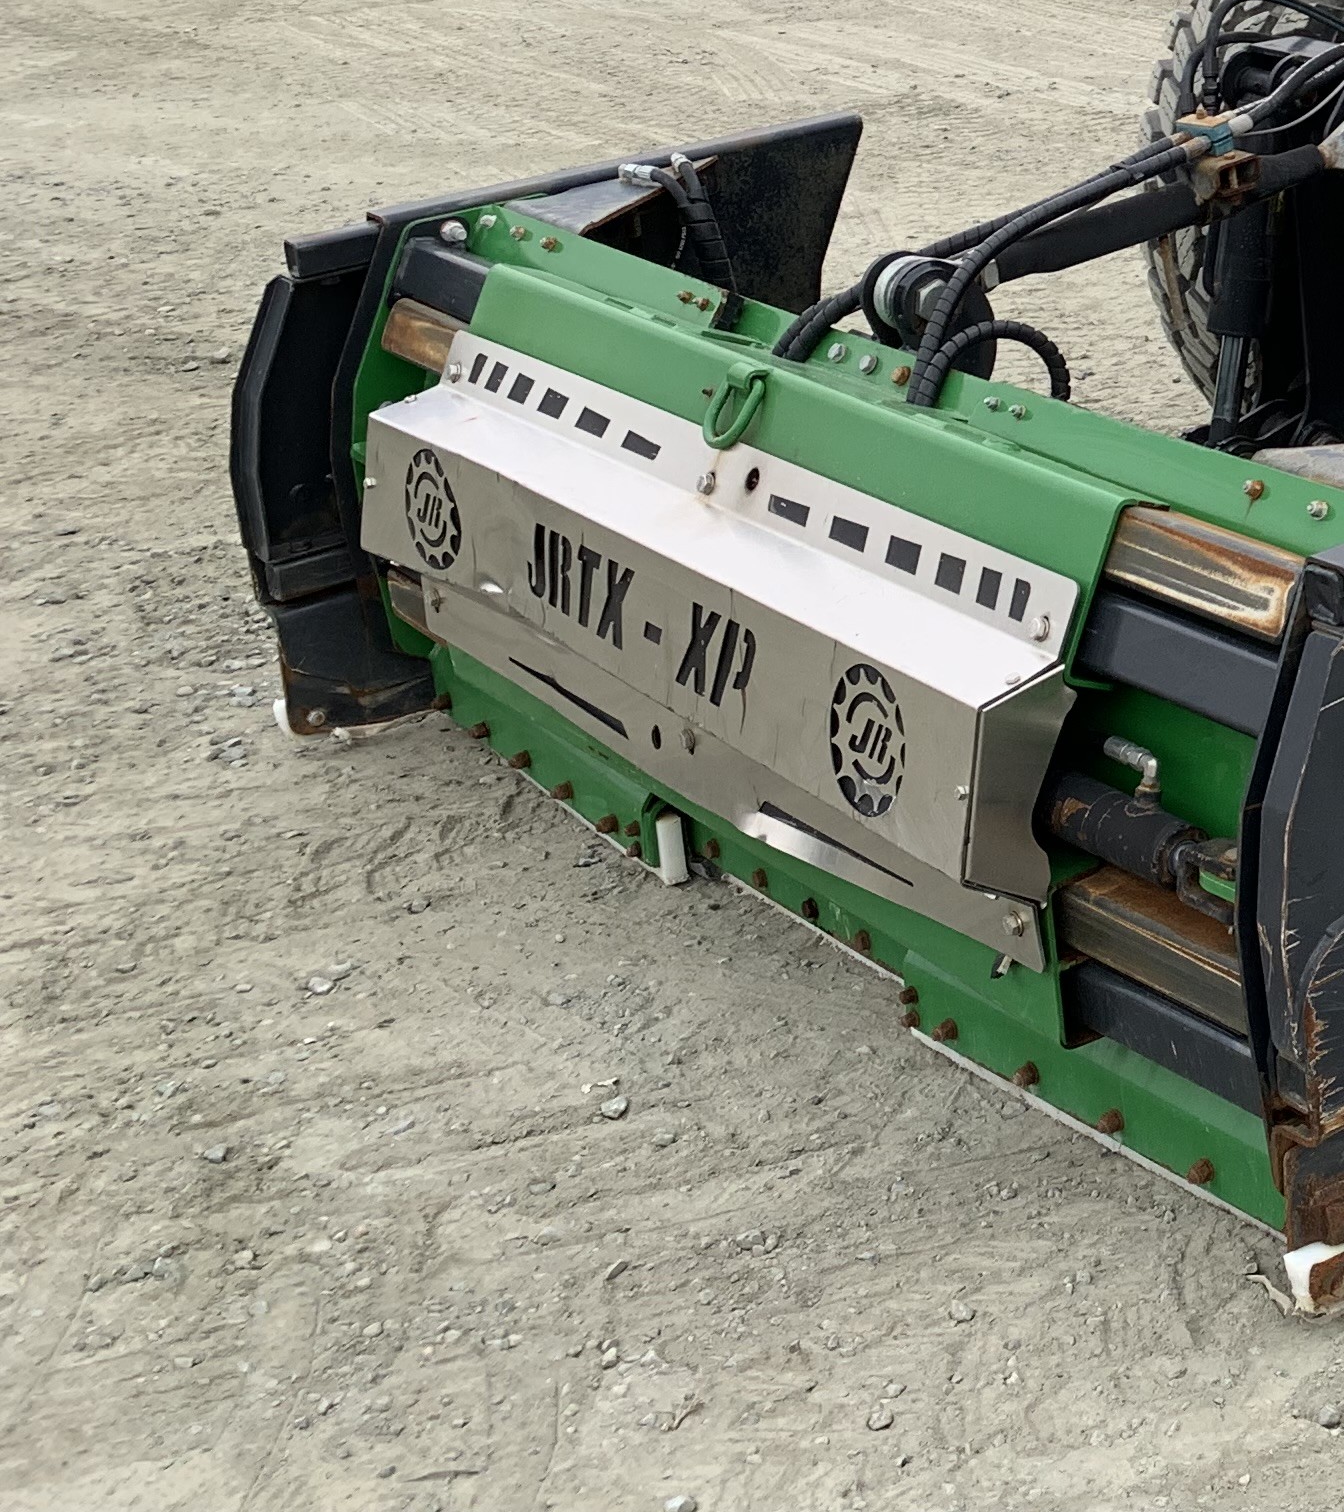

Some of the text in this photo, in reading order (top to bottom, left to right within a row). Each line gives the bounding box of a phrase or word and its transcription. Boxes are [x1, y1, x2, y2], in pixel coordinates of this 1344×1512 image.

[526, 522, 636, 651] JRTX
[675, 601, 757, 708] XP
[848, 717, 893, 765] JR
